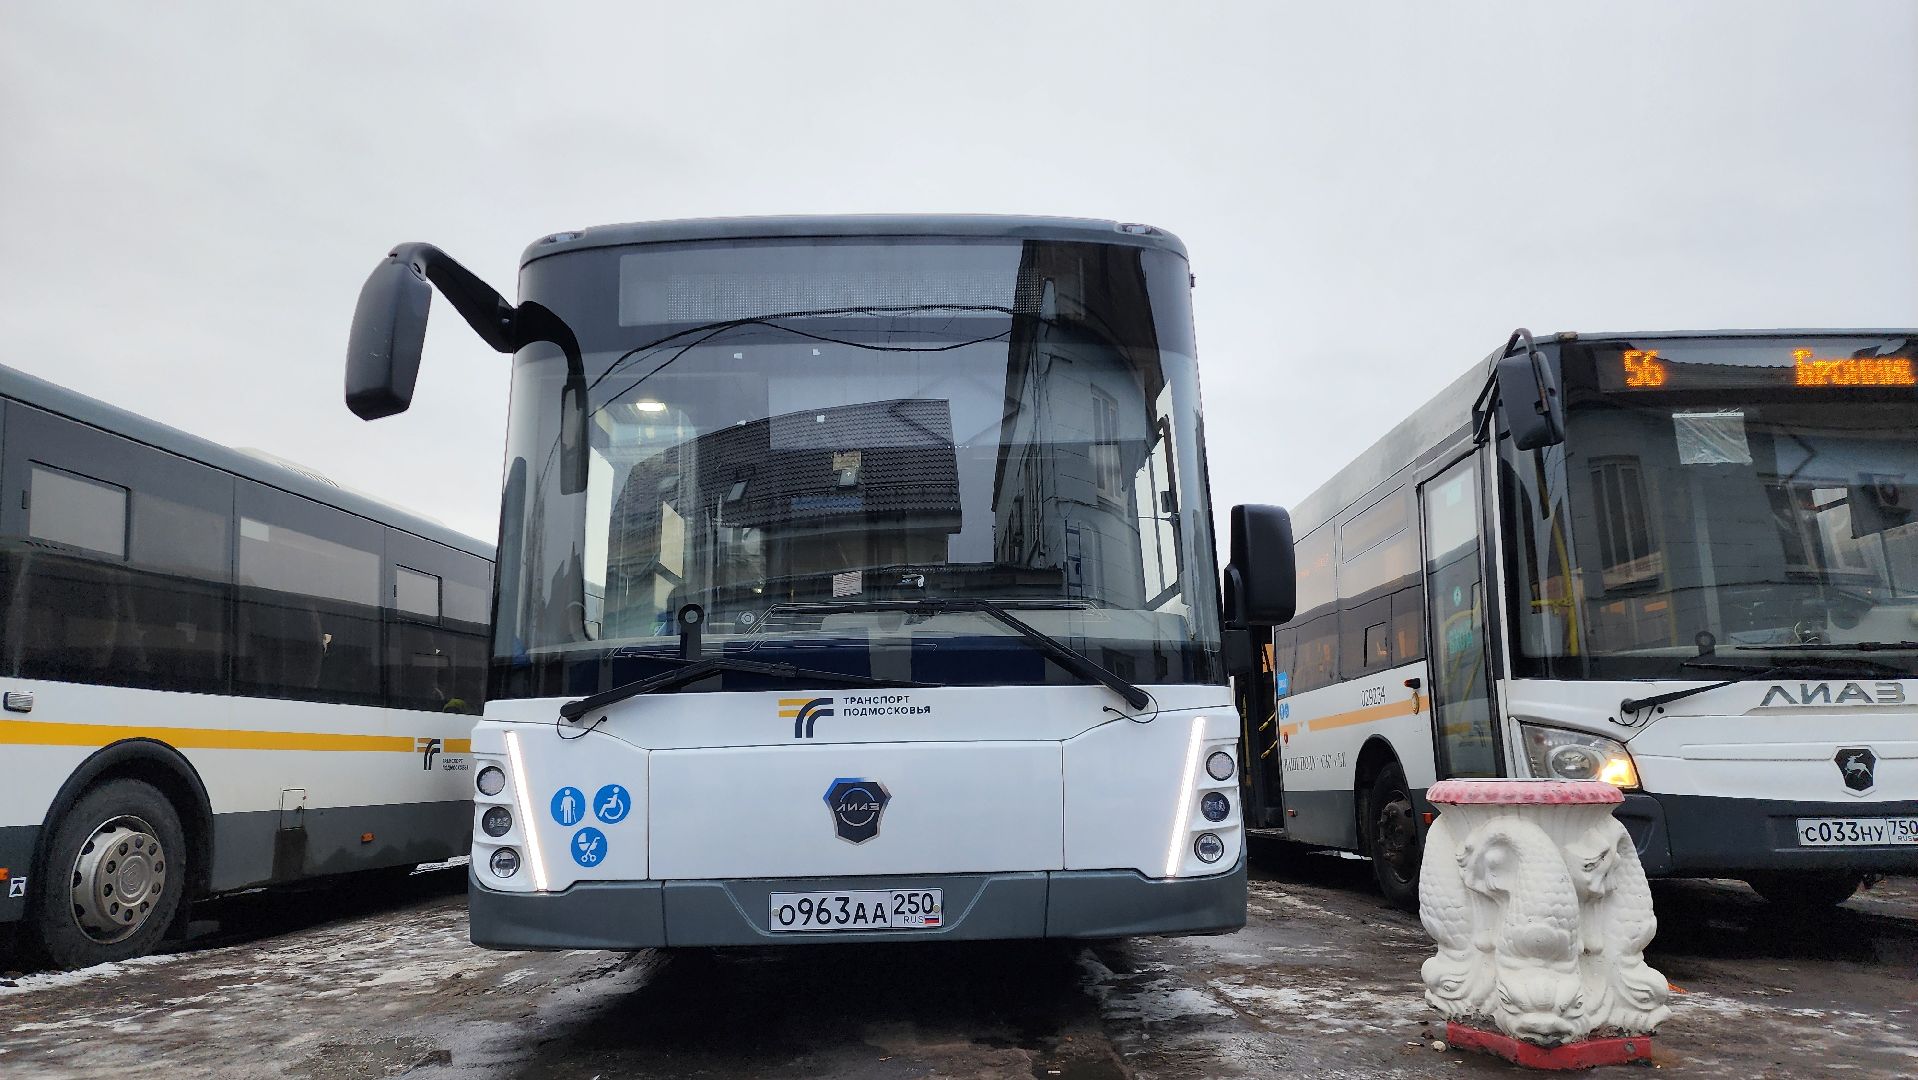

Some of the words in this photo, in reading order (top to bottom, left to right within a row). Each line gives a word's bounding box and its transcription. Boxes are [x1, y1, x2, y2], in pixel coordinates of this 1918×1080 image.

[1624, 350, 1663, 386] 56
[843, 695, 910, 705] ТРАНСПОРТ
[1760, 682, 1906, 706] ЛИАЗ
[843, 705, 931, 716] ПОДМОСКОВЬЯ
[836, 802, 880, 812] ЛИАЗ
[1805, 822, 1884, 842] С033НУ
[1888, 820, 1918, 835] 750
[778, 897, 887, 926] О963АА
[893, 893, 934, 915] 250
[903, 915, 924, 924] RUS
